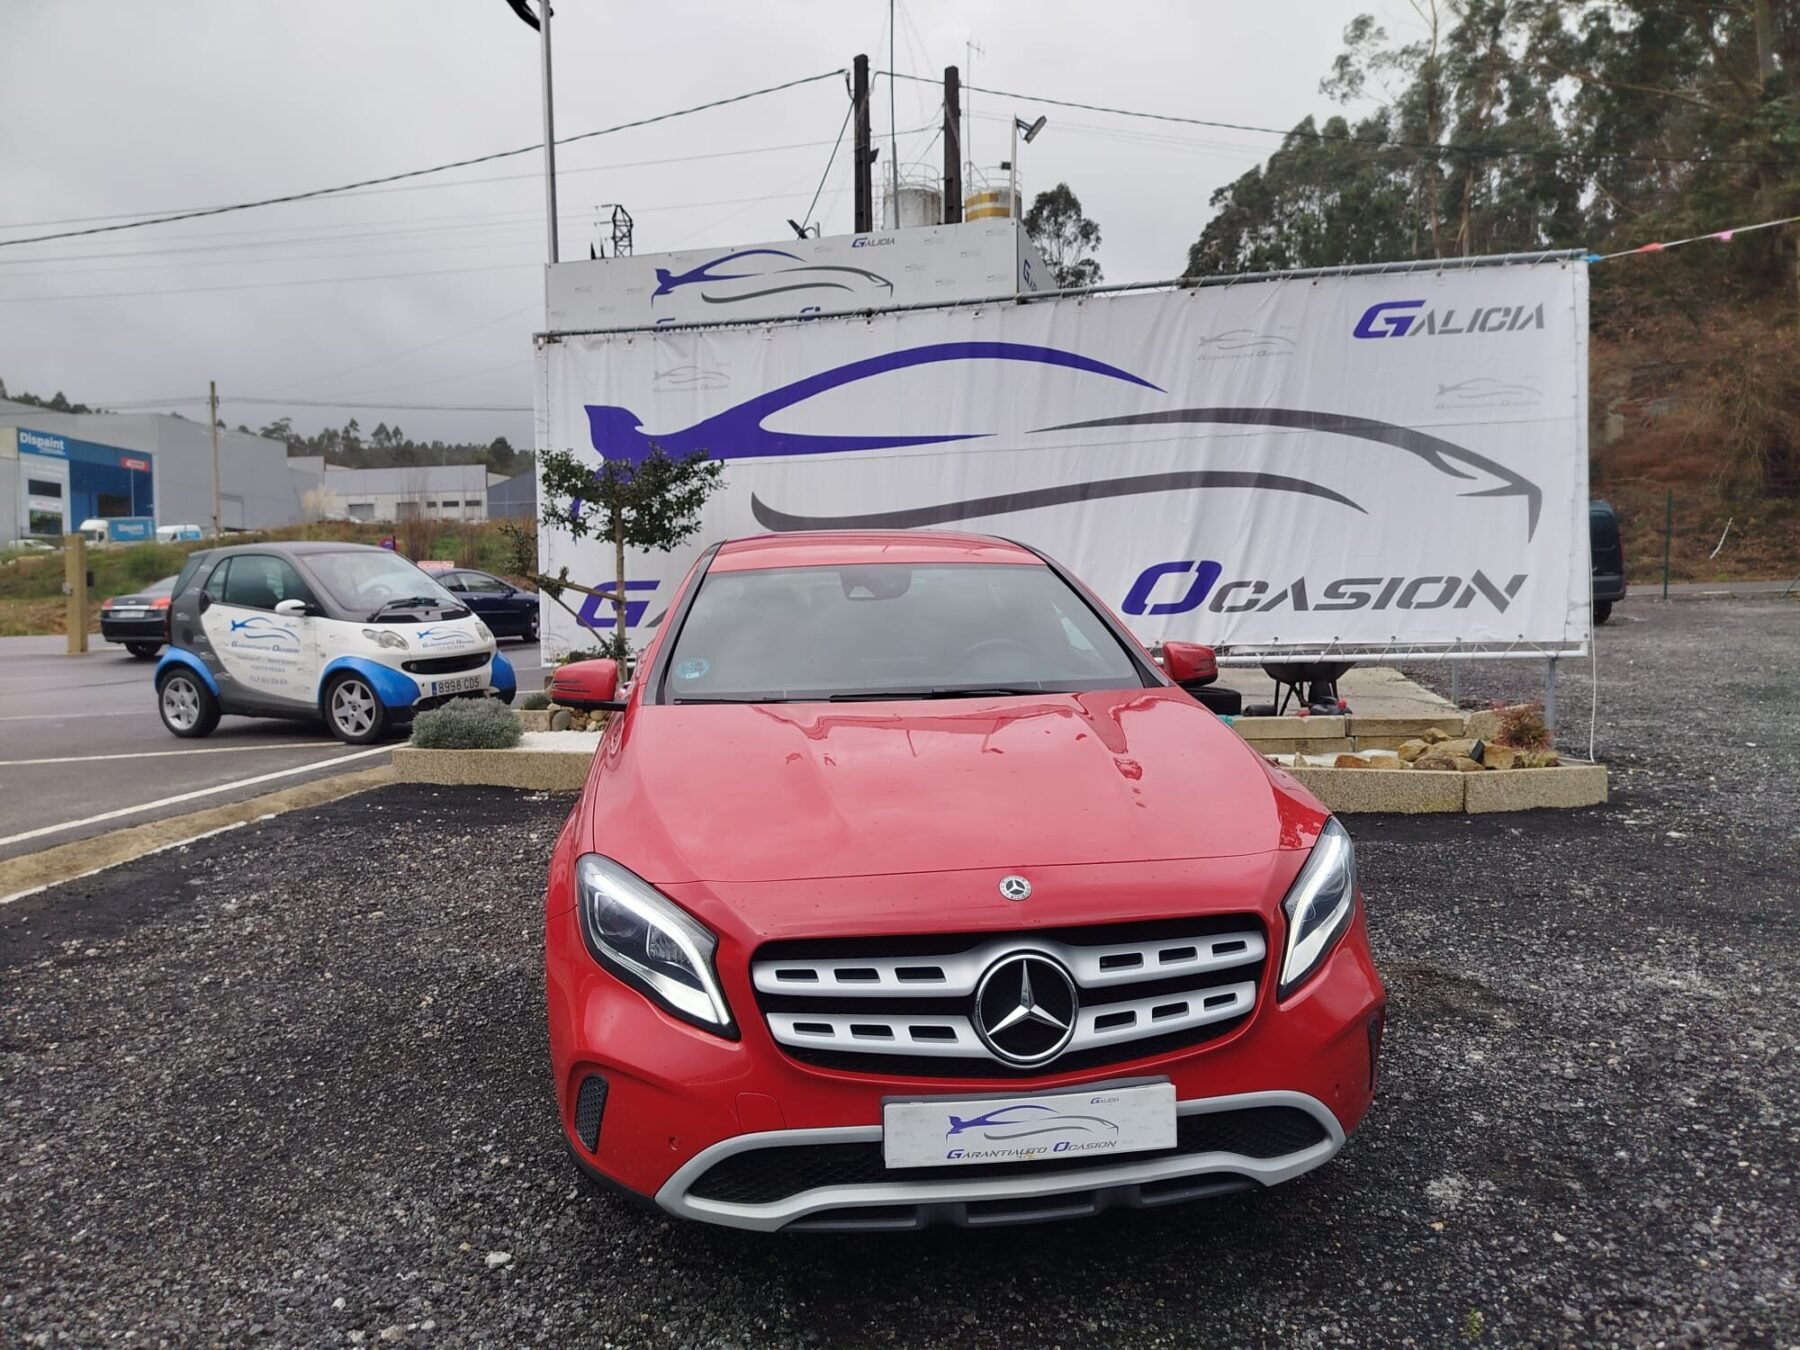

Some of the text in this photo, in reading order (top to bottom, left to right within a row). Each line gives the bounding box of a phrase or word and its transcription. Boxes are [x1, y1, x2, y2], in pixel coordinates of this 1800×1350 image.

[1353, 300, 1544, 339] GALICIA
[20, 432, 64, 450] Dispaint
[1121, 560, 1529, 615] OCASION
[439, 677, 479, 693] 8998 CDS
[946, 1141, 1117, 1159] GARANTIAUTO OCASION
